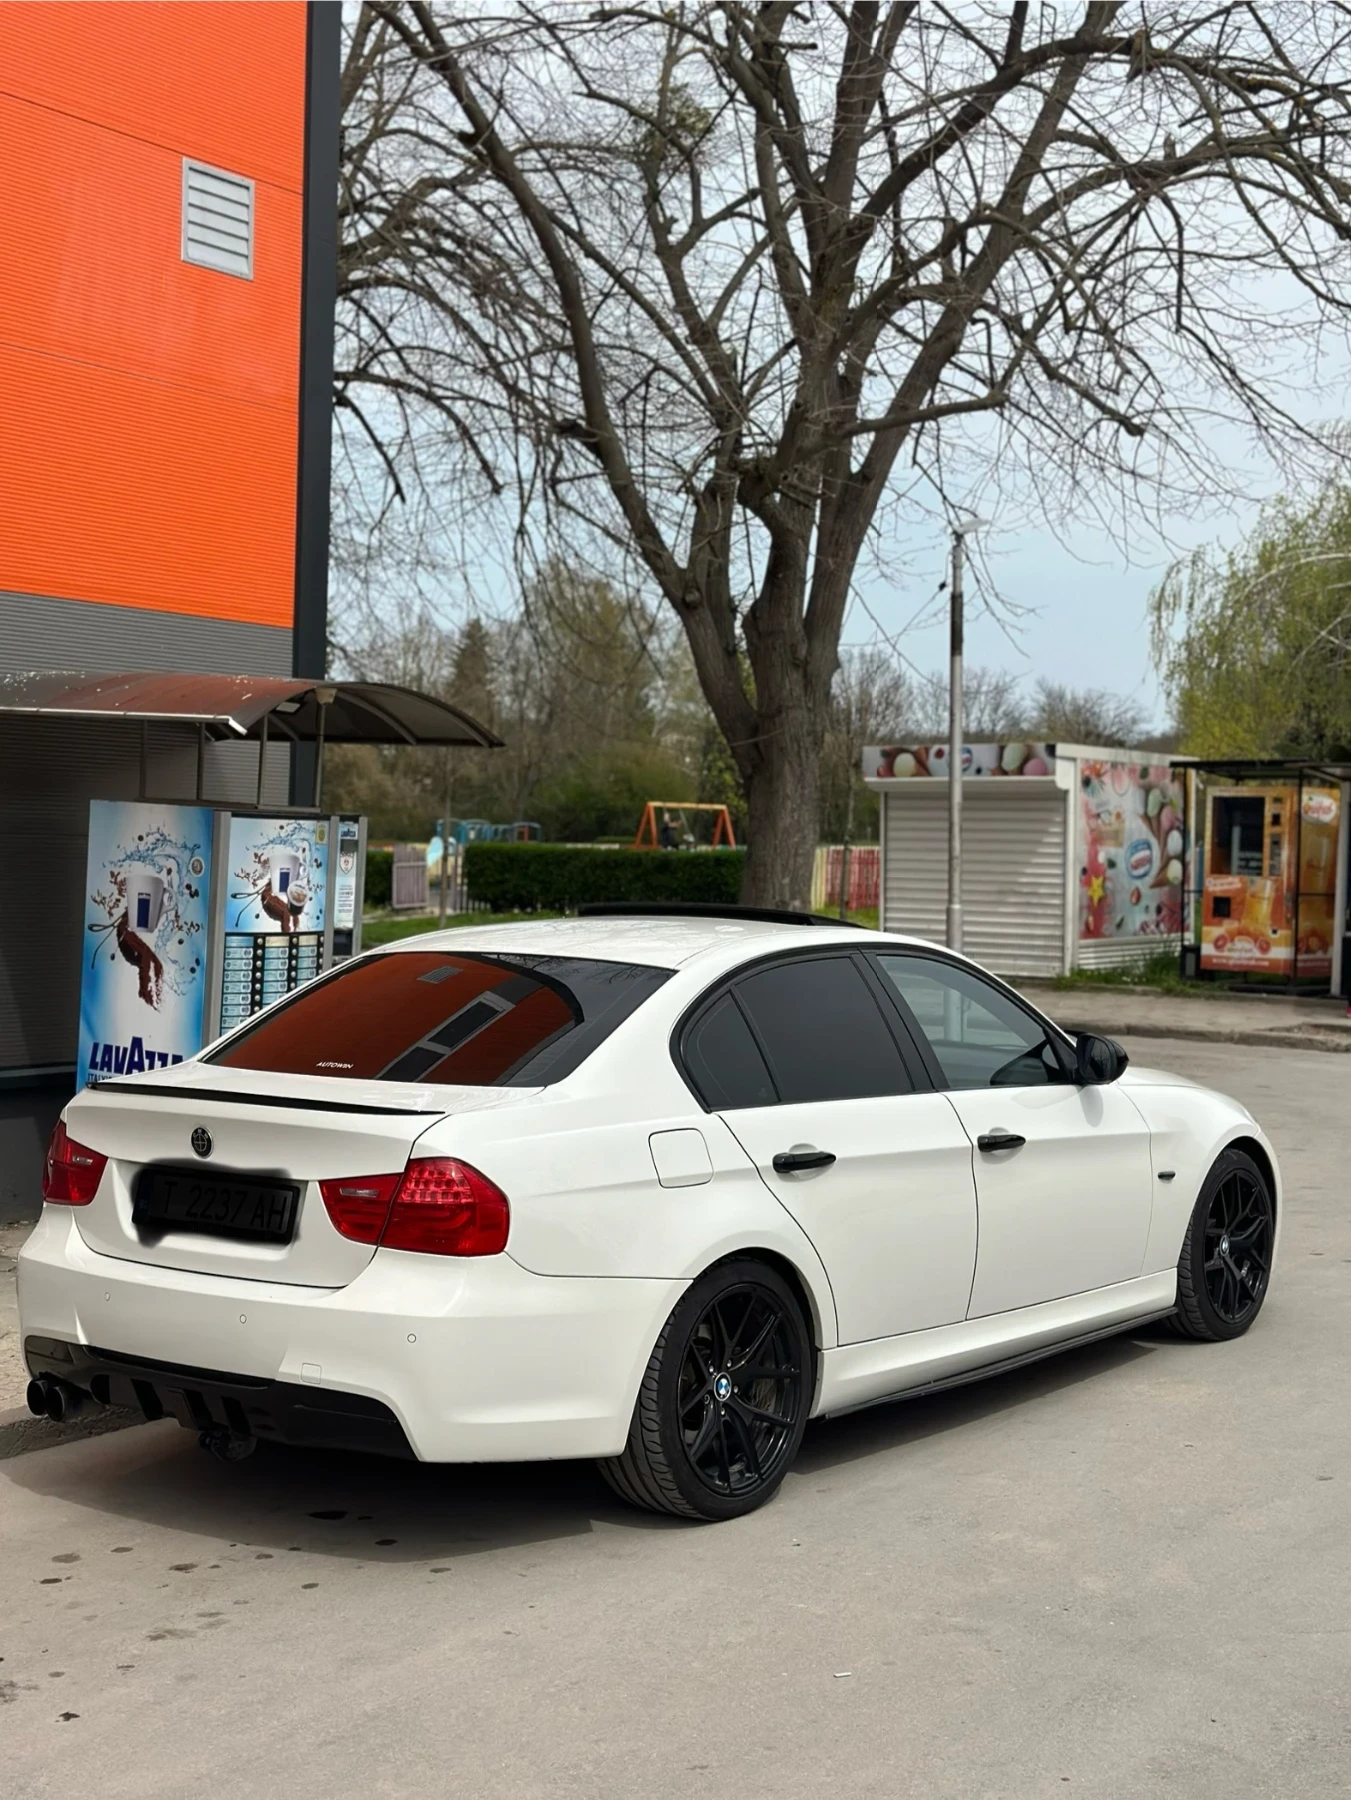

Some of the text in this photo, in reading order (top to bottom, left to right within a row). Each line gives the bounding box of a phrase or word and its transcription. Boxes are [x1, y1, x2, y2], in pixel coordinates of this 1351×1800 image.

[315, 1061, 354, 1069] AUTOWIN
[164, 1180, 288, 1230] T 2237 AH
